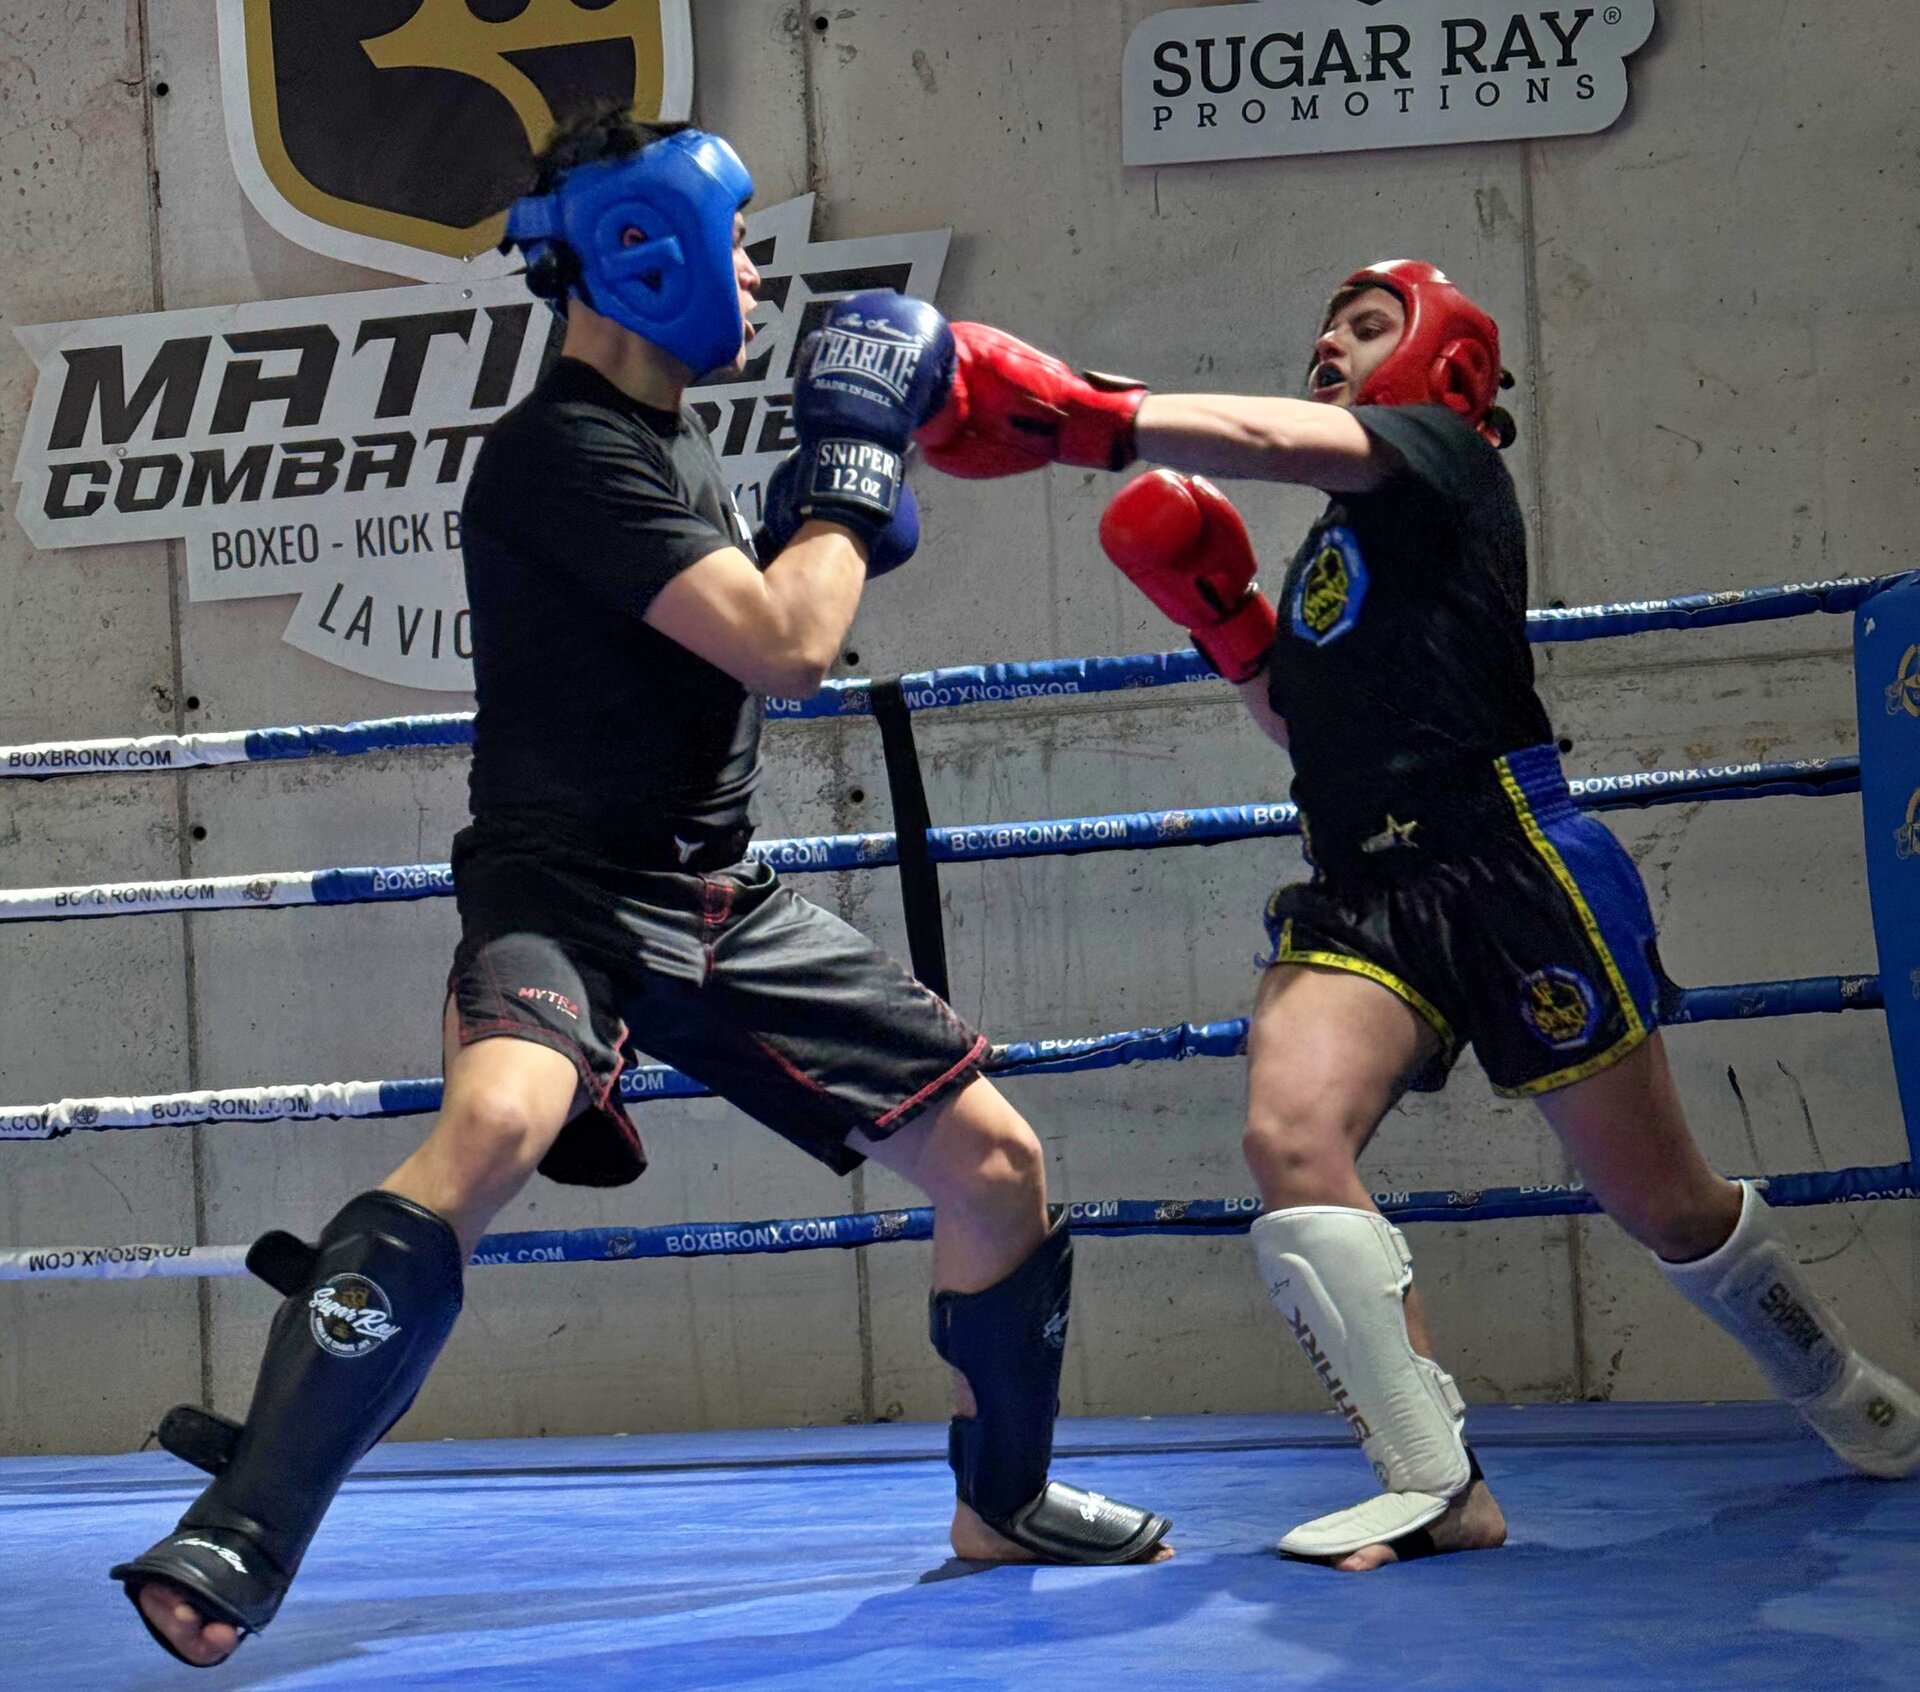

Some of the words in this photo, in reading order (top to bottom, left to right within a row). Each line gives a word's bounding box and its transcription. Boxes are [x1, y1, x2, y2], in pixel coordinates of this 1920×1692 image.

[1153, 24, 1411, 97] SUGAR
[1441, 9, 1594, 77] RAY
[1152, 74, 1595, 130] PROMOTIONS
[812, 330, 922, 398] CHARLIE
[44, 423, 494, 519] COMBAT
[820, 444, 894, 479] SNIPER
[831, 468, 858, 491] 12
[212, 524, 318, 571] BOXEO
[356, 513, 433, 558] KICK
[318, 583, 373, 646] LA
[9, 750, 171, 767] BOXBRONX.COM
[1568, 763, 1761, 796] BOXBRONX.COM
[951, 821, 1127, 851] BOXBRONX.COM
[55, 884, 214, 907] BOBRONX.COM
[666, 1221, 837, 1252] BOXBRONX.COM
